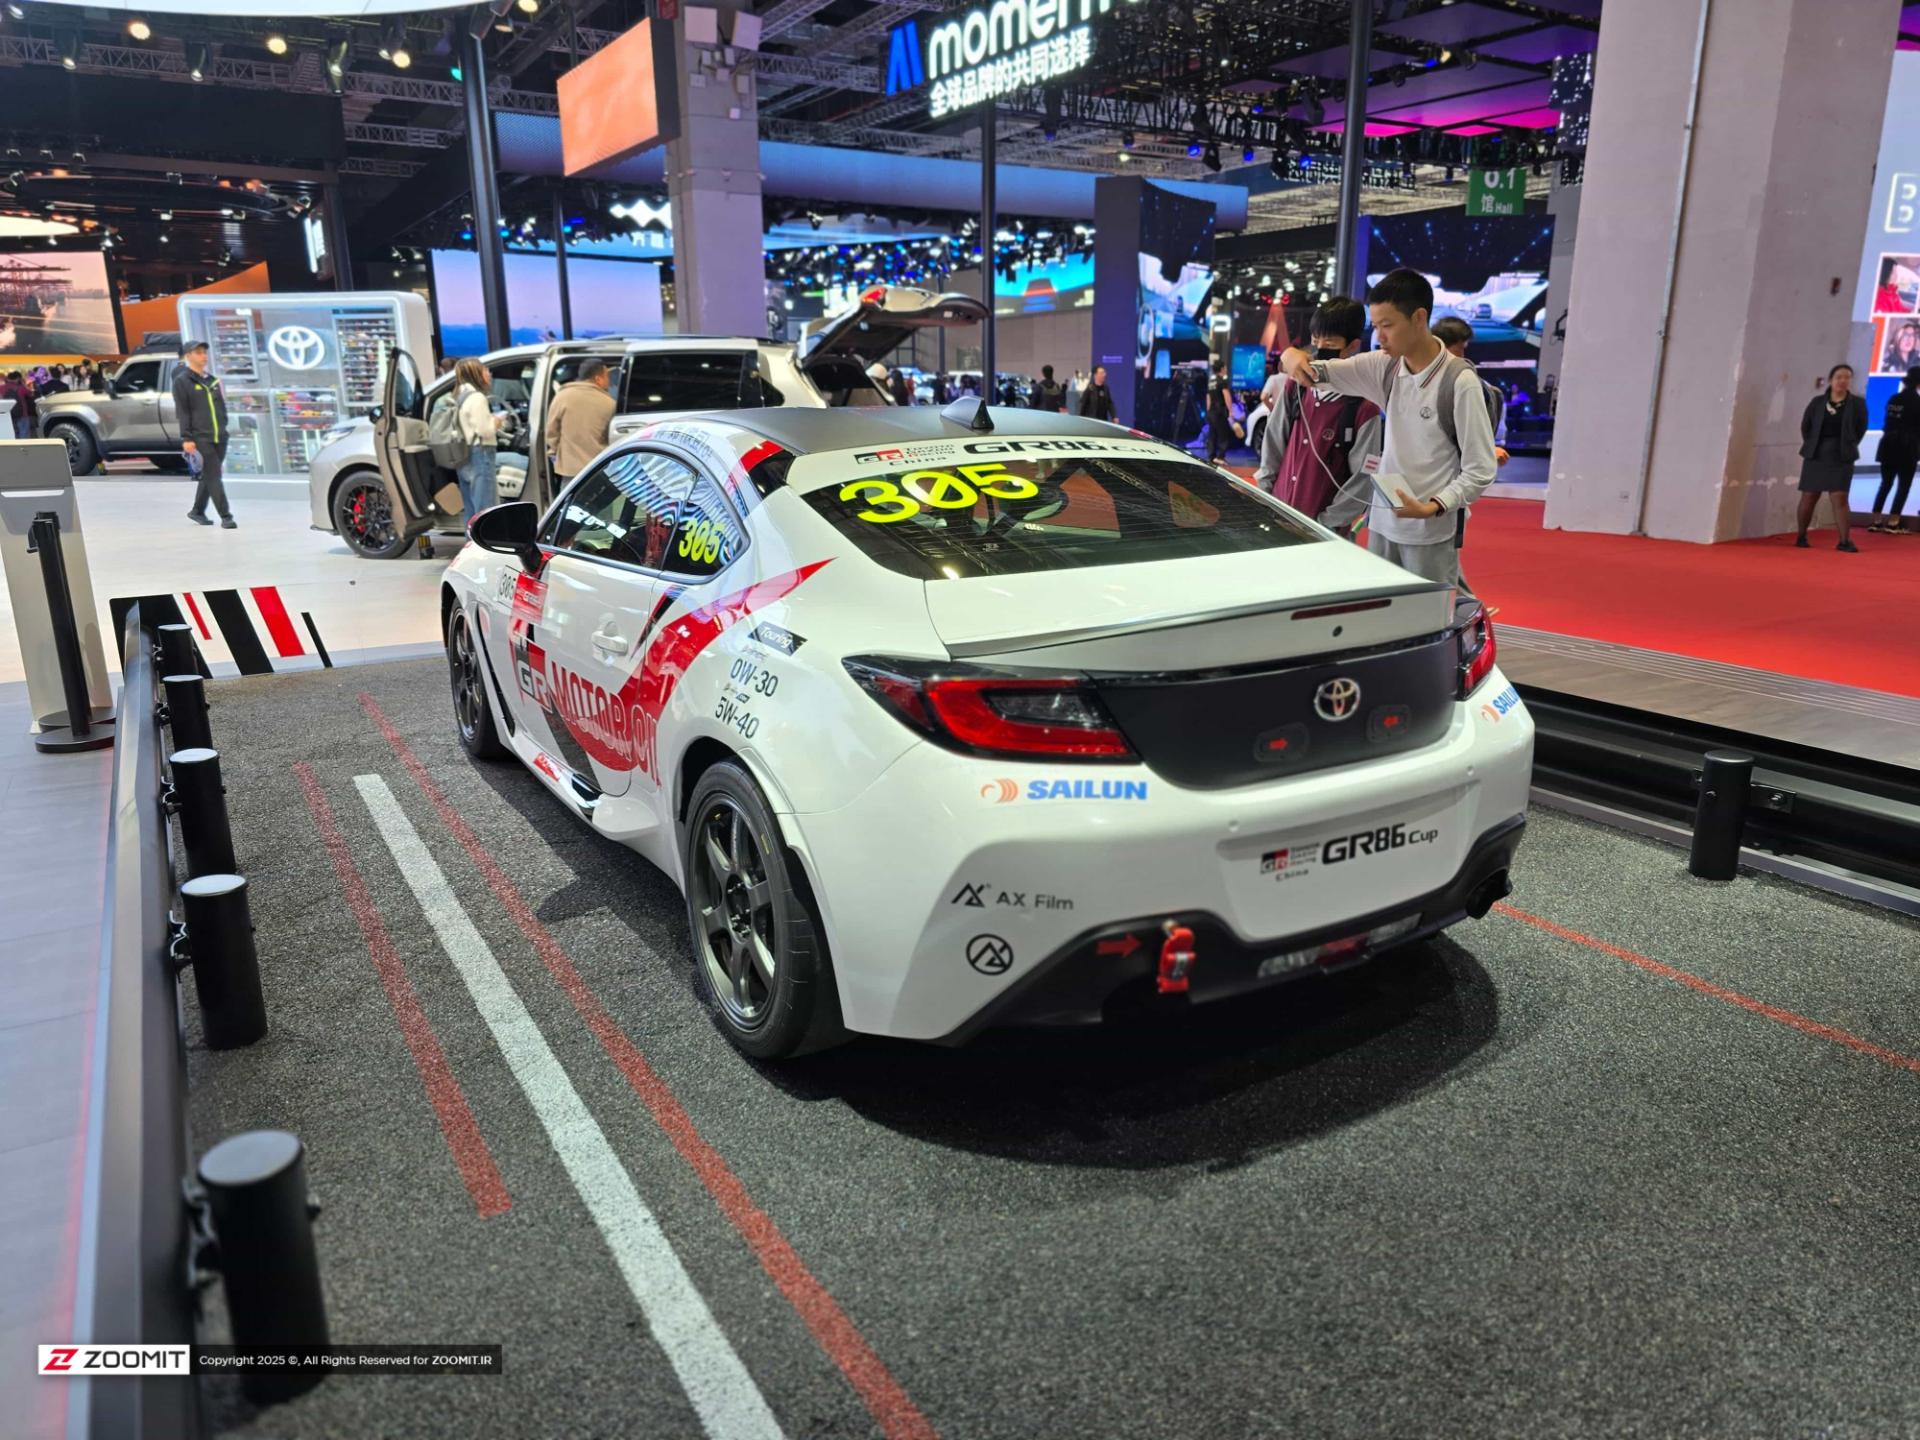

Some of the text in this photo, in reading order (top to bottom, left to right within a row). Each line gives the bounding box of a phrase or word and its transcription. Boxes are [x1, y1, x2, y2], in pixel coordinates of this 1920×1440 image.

[929, 26, 1091, 118] 全球品牌的共同选择
[1495, 202, 1513, 215] Hall
[963, 441, 1160, 455] GR86 Cup
[839, 463, 1040, 524] 305
[679, 518, 727, 564] 305
[760, 626, 793, 649] Touring
[516, 658, 553, 714] GR
[730, 658, 779, 697] 0W-30
[551, 660, 633, 762] MOTOR
[715, 696, 759, 739] 5W-40
[1026, 779, 1148, 800] SAILUN
[1322, 823, 1439, 866] GR86 Cup
[1275, 868, 1309, 882] China
[996, 891, 1074, 910] AX Film
